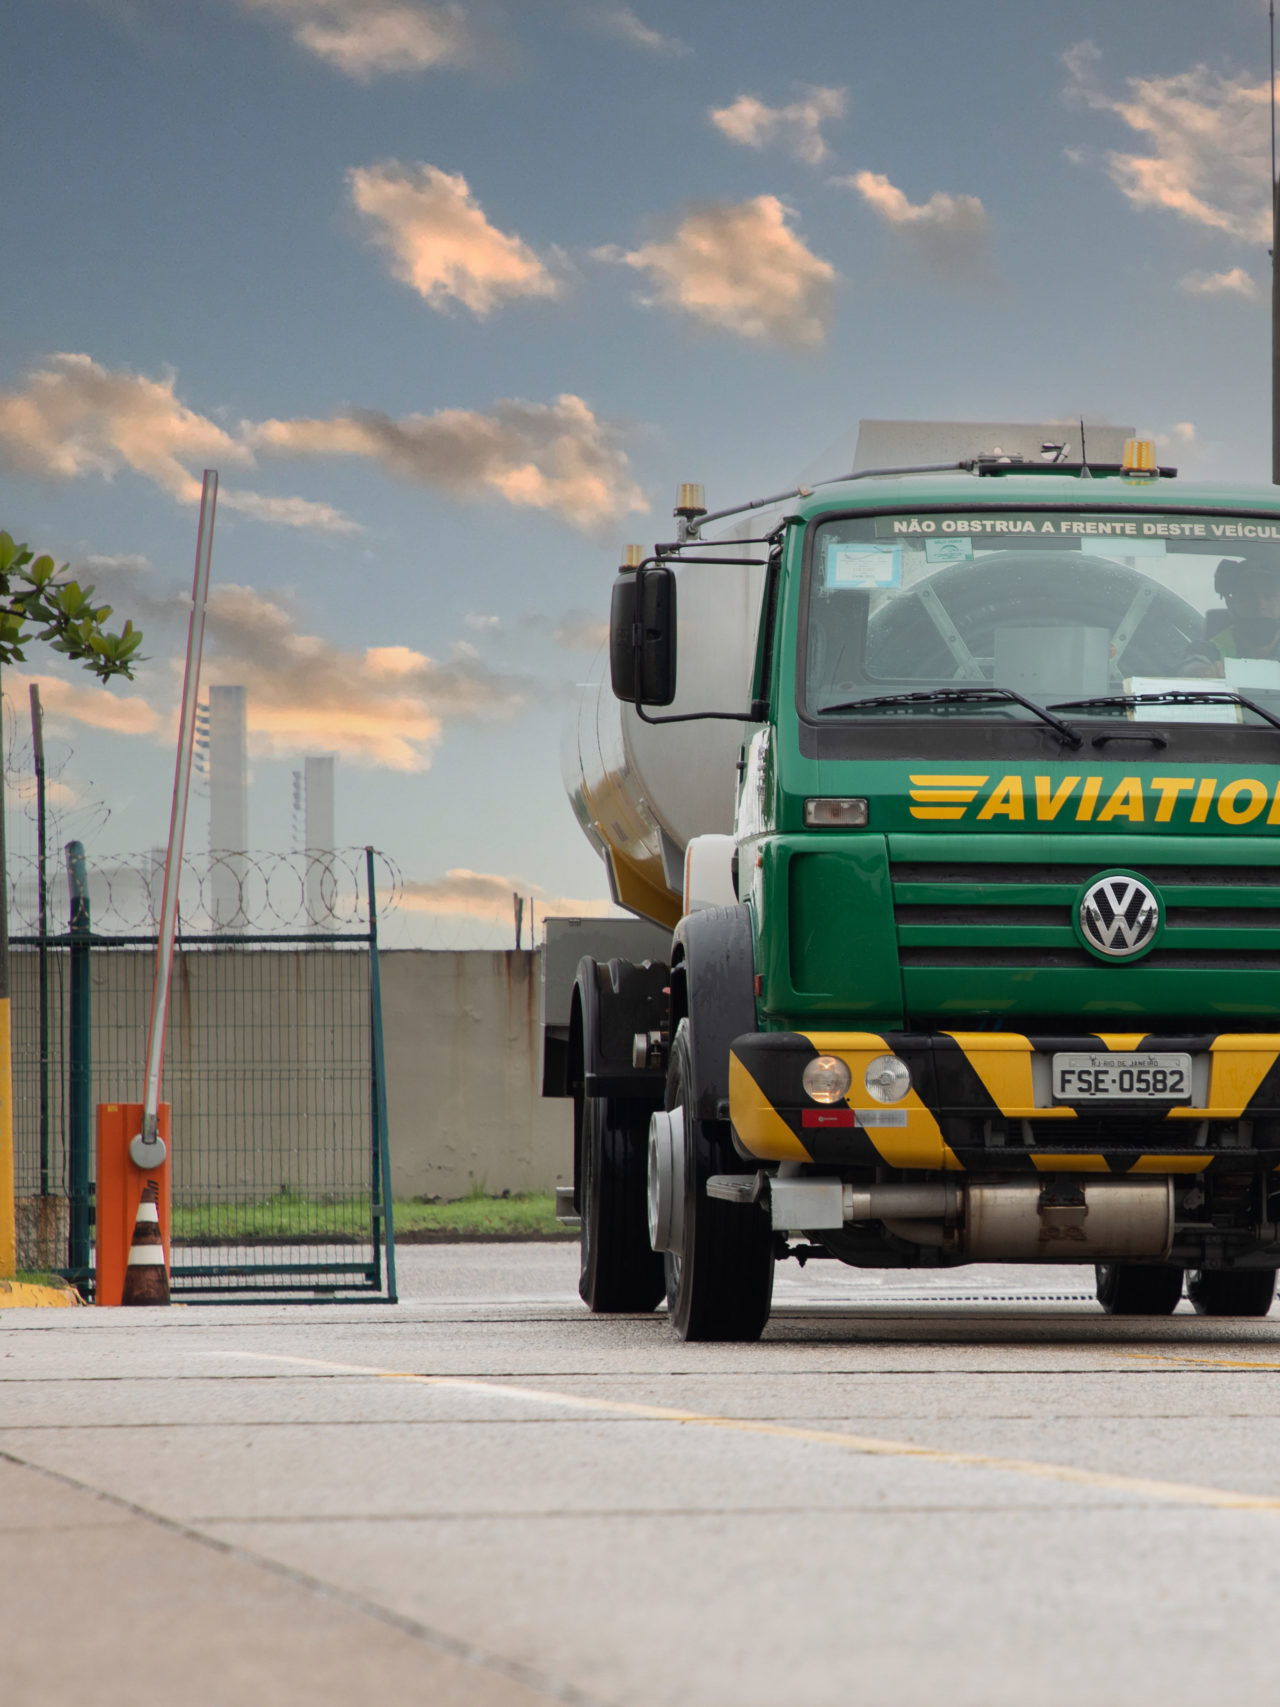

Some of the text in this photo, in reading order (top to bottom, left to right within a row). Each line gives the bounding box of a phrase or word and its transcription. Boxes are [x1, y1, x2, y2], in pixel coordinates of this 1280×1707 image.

[893, 519, 936, 533] NÃO
[942, 520, 1036, 533] OBSTRUA
[1041, 521, 1055, 533] A
[1060, 521, 1137, 534] FRENTE
[1143, 523, 1206, 536] DESTE
[1080, 876, 1158, 956] VW
